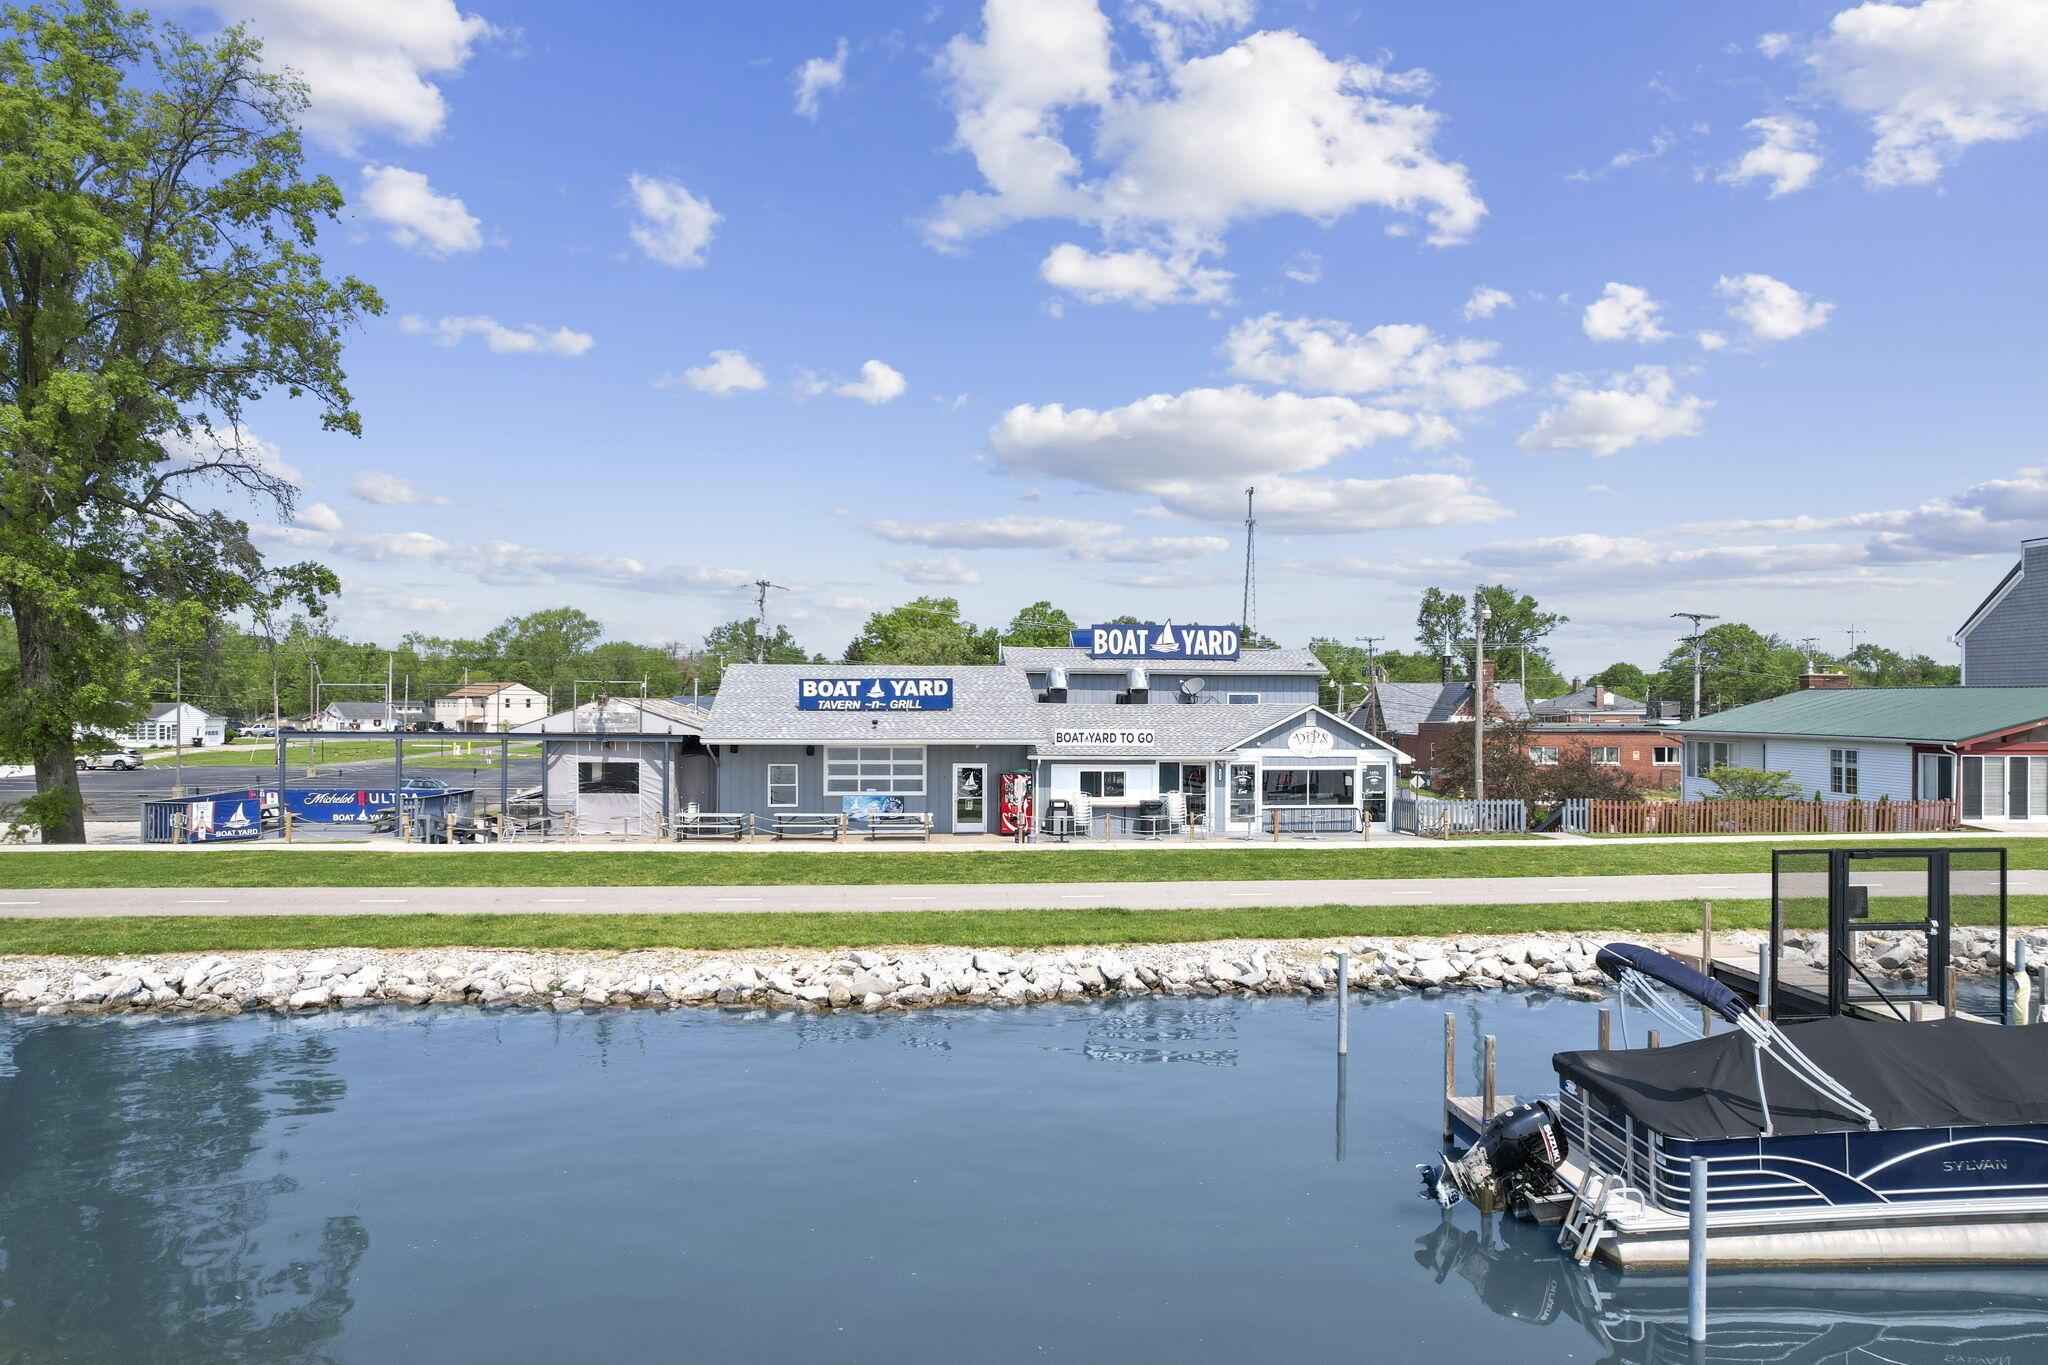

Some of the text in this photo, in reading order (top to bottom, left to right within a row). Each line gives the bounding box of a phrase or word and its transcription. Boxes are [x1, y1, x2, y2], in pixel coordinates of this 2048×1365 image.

[1093, 629, 1238, 656] BOAT YARD
[802, 679, 949, 697] BOAT YARD
[818, 700, 861, 710] TAVERN
[890, 700, 923, 709] GRILL
[1056, 732, 1154, 744] BOAT YARD TO GO
[304, 792, 356, 805] Michelob
[333, 813, 355, 821] BOAT
[215, 828, 258, 838] BOAT YARD
[1543, 1123, 1561, 1164] SUZUKI
[1942, 1159, 2008, 1172] SYLVAN
